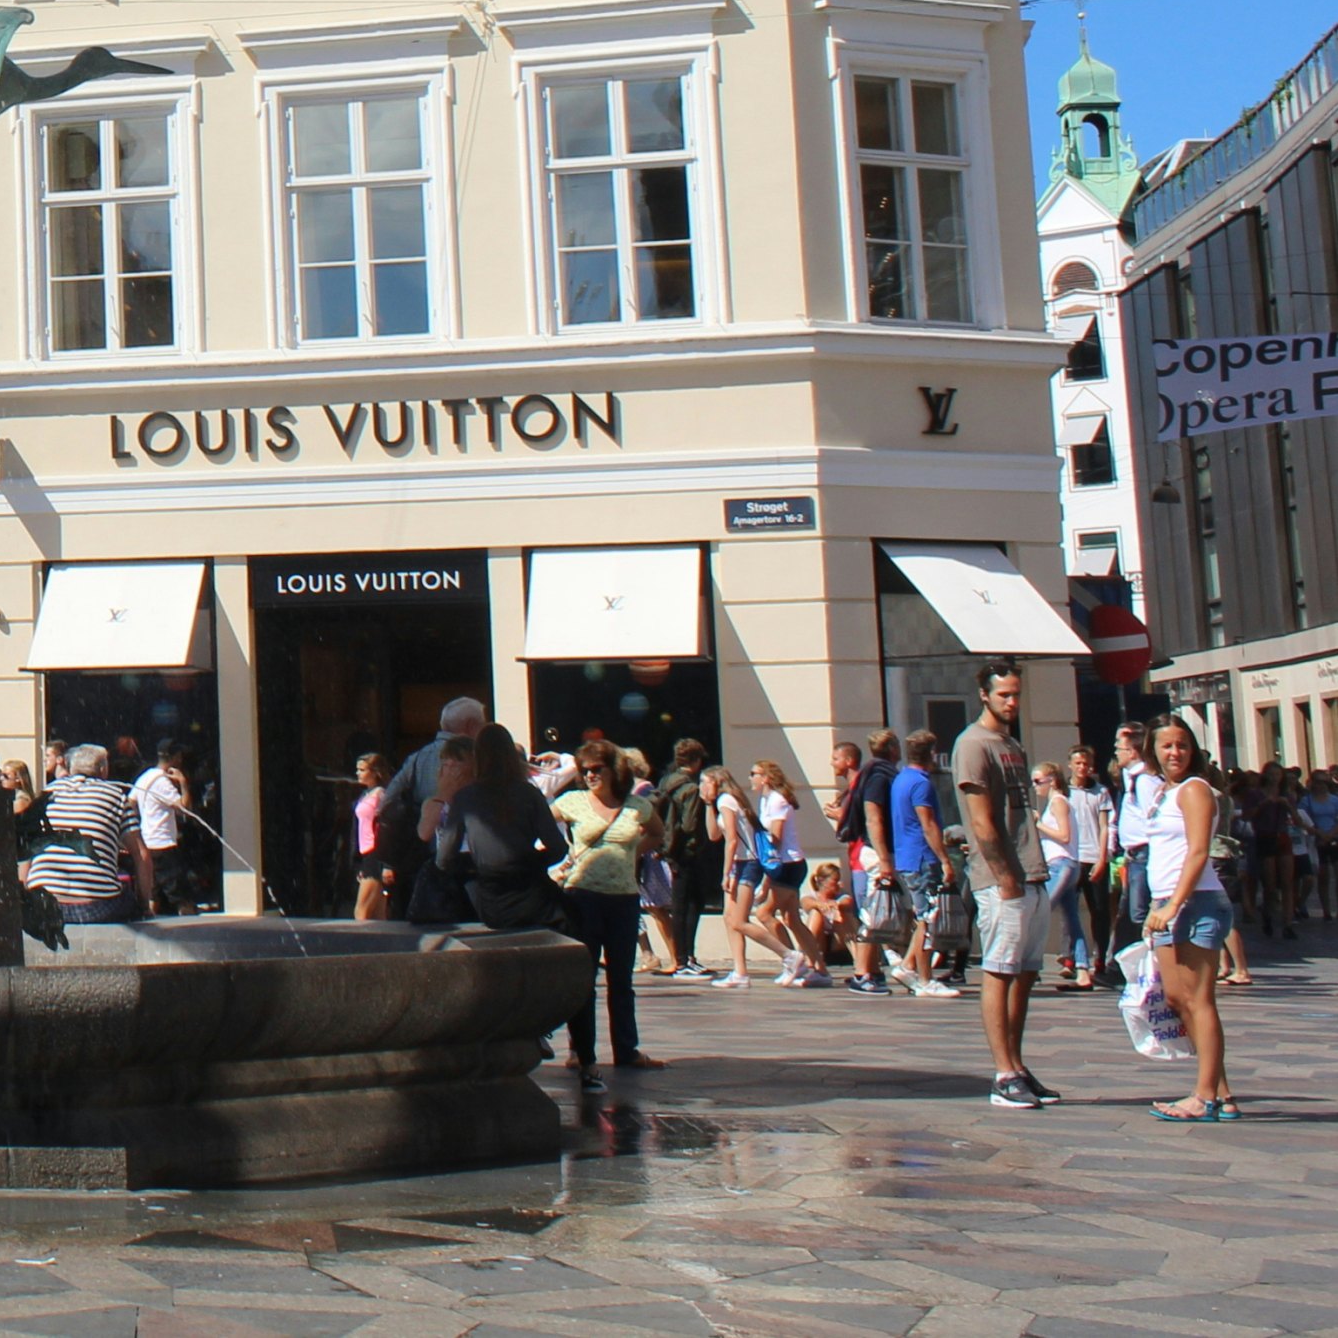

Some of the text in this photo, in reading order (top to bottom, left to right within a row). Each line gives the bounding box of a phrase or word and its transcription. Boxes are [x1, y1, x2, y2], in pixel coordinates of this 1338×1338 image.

[110, 391, 622, 461] LOUIS VUITTON
[746, 501, 789, 514] Strøget
[277, 570, 461, 593] LOUIS VUITTON
